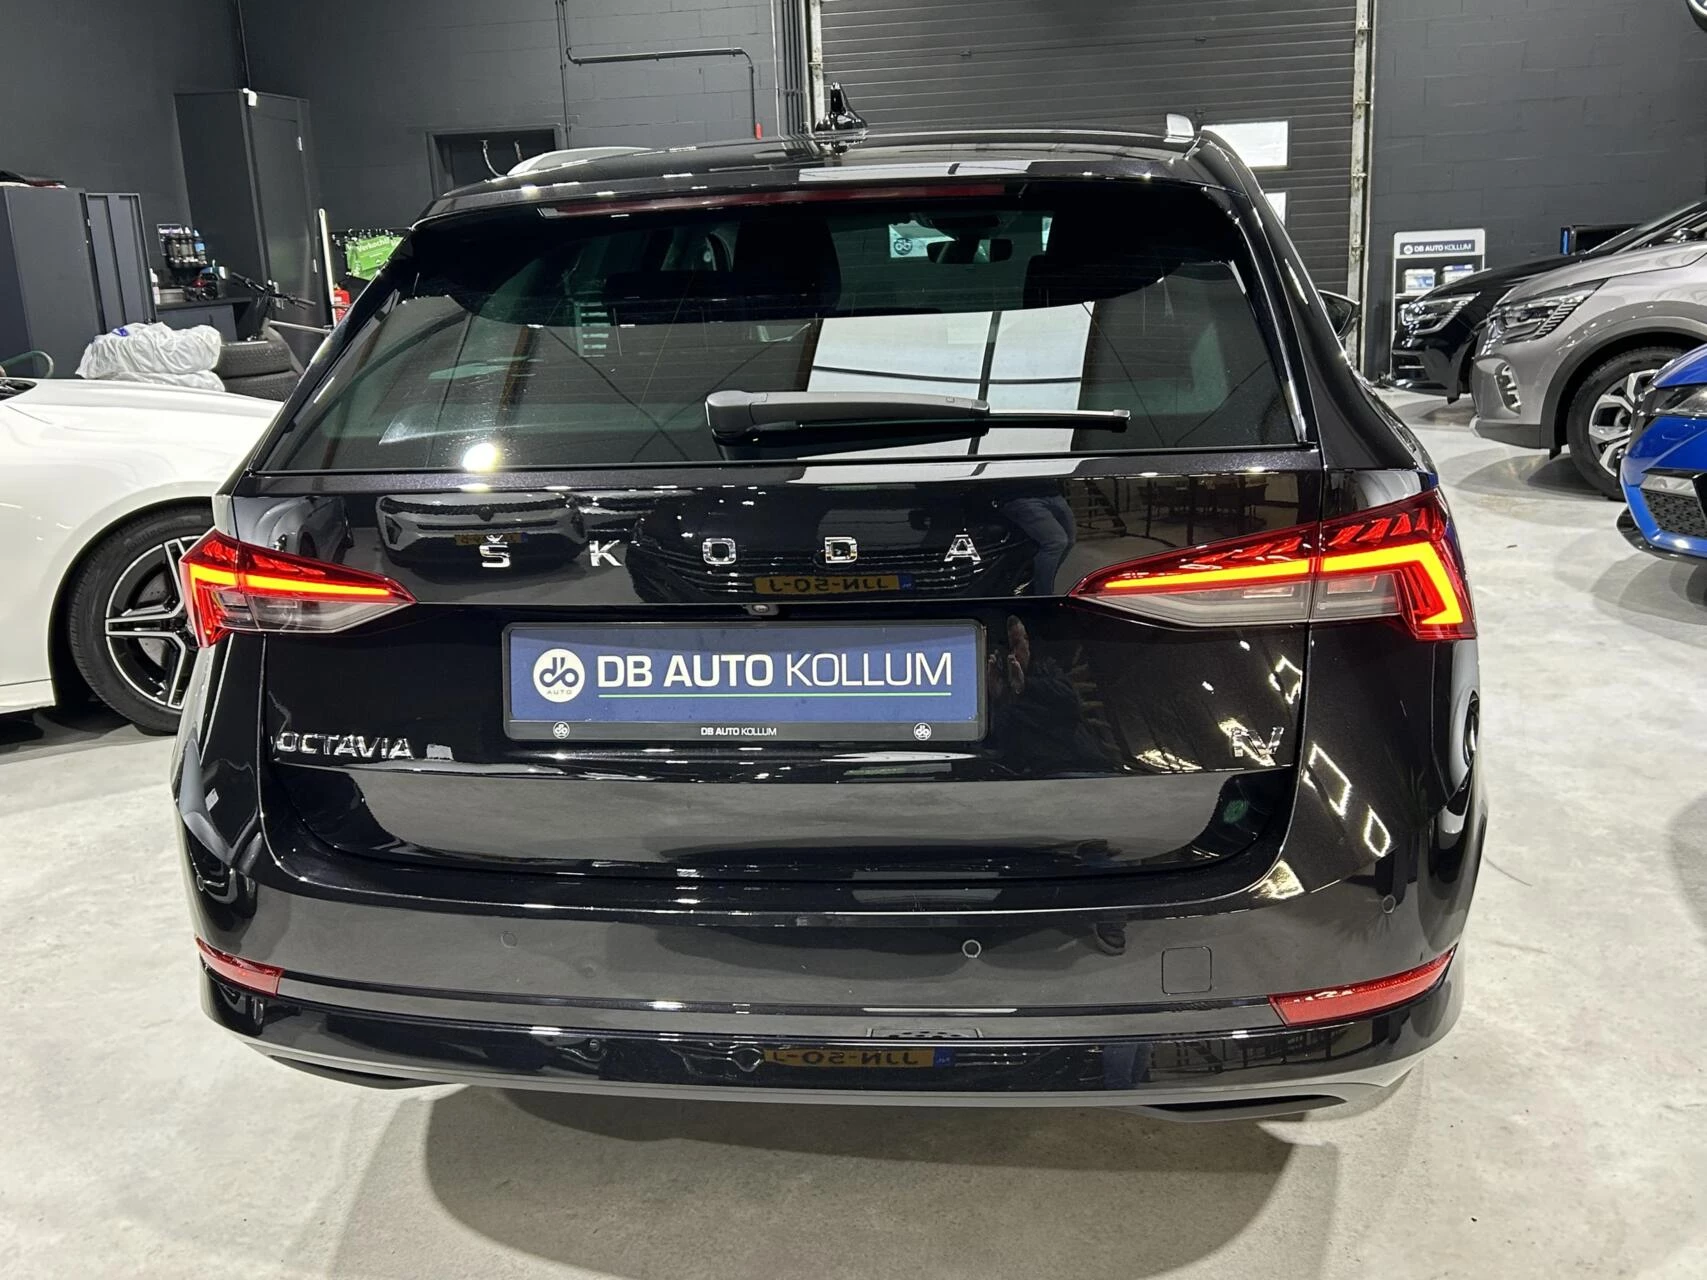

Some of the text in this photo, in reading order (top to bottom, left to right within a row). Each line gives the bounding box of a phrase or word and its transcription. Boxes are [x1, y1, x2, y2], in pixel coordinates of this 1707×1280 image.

[1414, 245, 1424, 253] DB
[1425, 244, 1444, 252] AUTO
[597, 652, 952, 688] DB AUTO KOLLUM
[700, 726, 777, 736] DB AUTO KOLLUM
[276, 731, 415, 760] OCTAVIA
